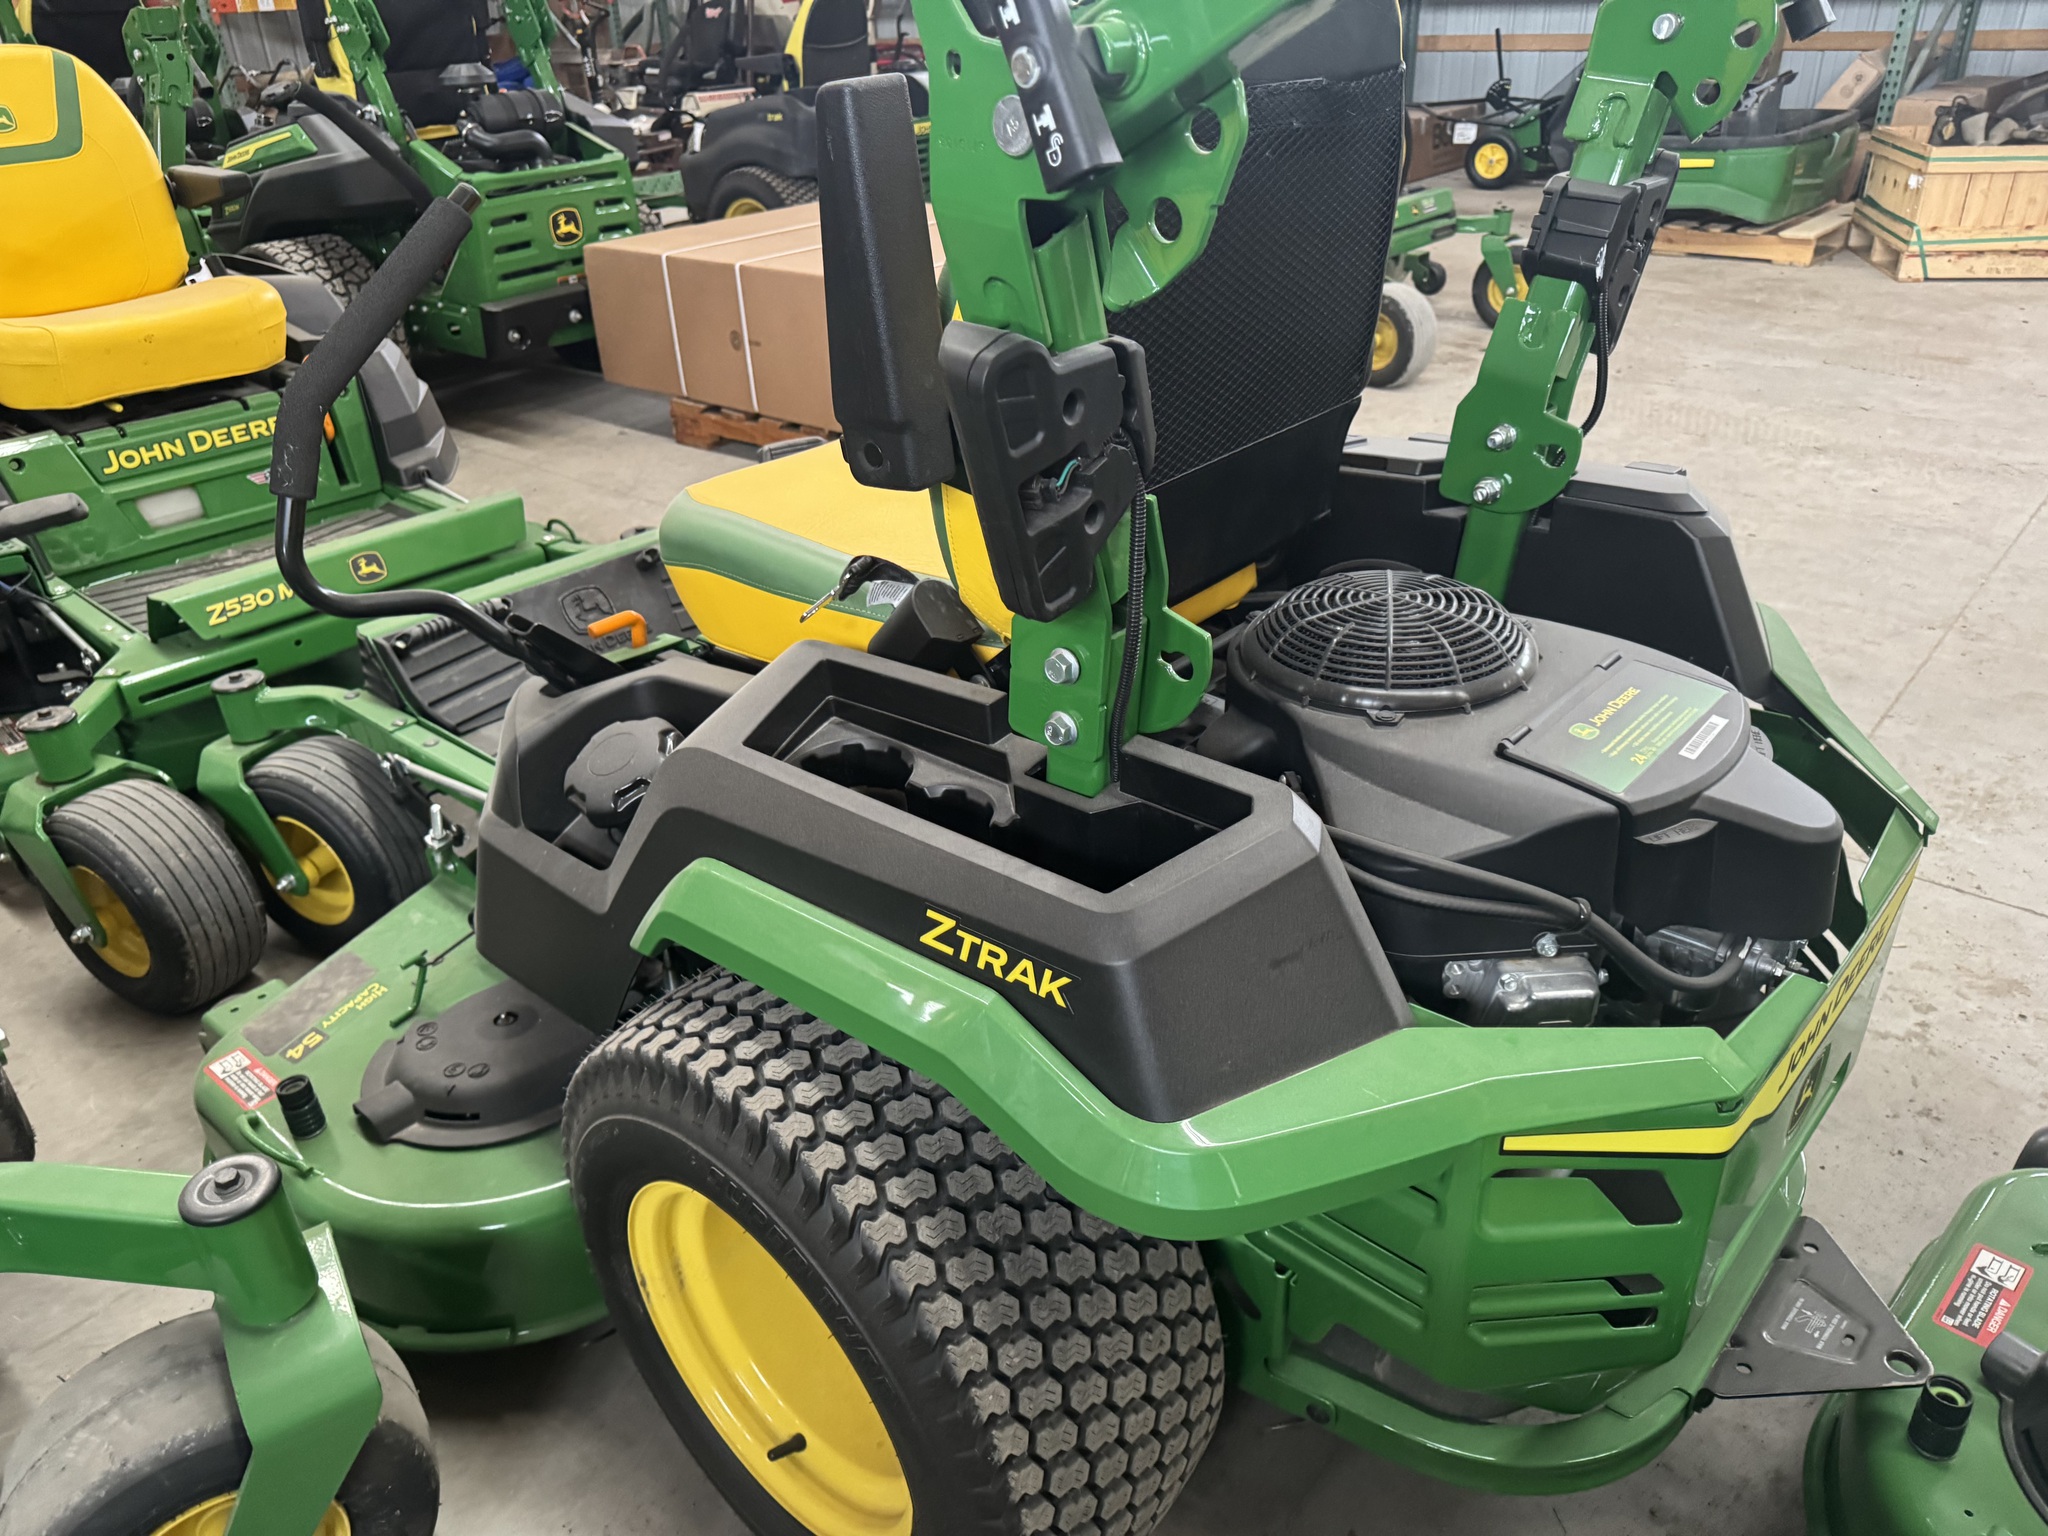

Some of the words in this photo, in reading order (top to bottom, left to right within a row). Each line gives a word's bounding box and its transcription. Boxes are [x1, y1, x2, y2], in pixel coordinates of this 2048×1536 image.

[103, 438, 185, 475] JOHN
[206, 587, 275, 626] Z530
[1589, 707, 1615, 727] JOHN
[1609, 686, 1641, 709] DEERE
[919, 908, 1073, 1009] ZTRAK
[322, 982, 380, 1029] CAPACITY
[357, 985, 389, 1012] HIGH
[1778, 1000, 1832, 1093] JOHN
[1832, 915, 1889, 1013] DEERE
[286, 1031, 324, 1060] 54
[1981, 1287, 1999, 1312] ROTATING
[1972, 1310, 1987, 1330] BLADE
[1986, 1304, 2009, 1334] DANGER
